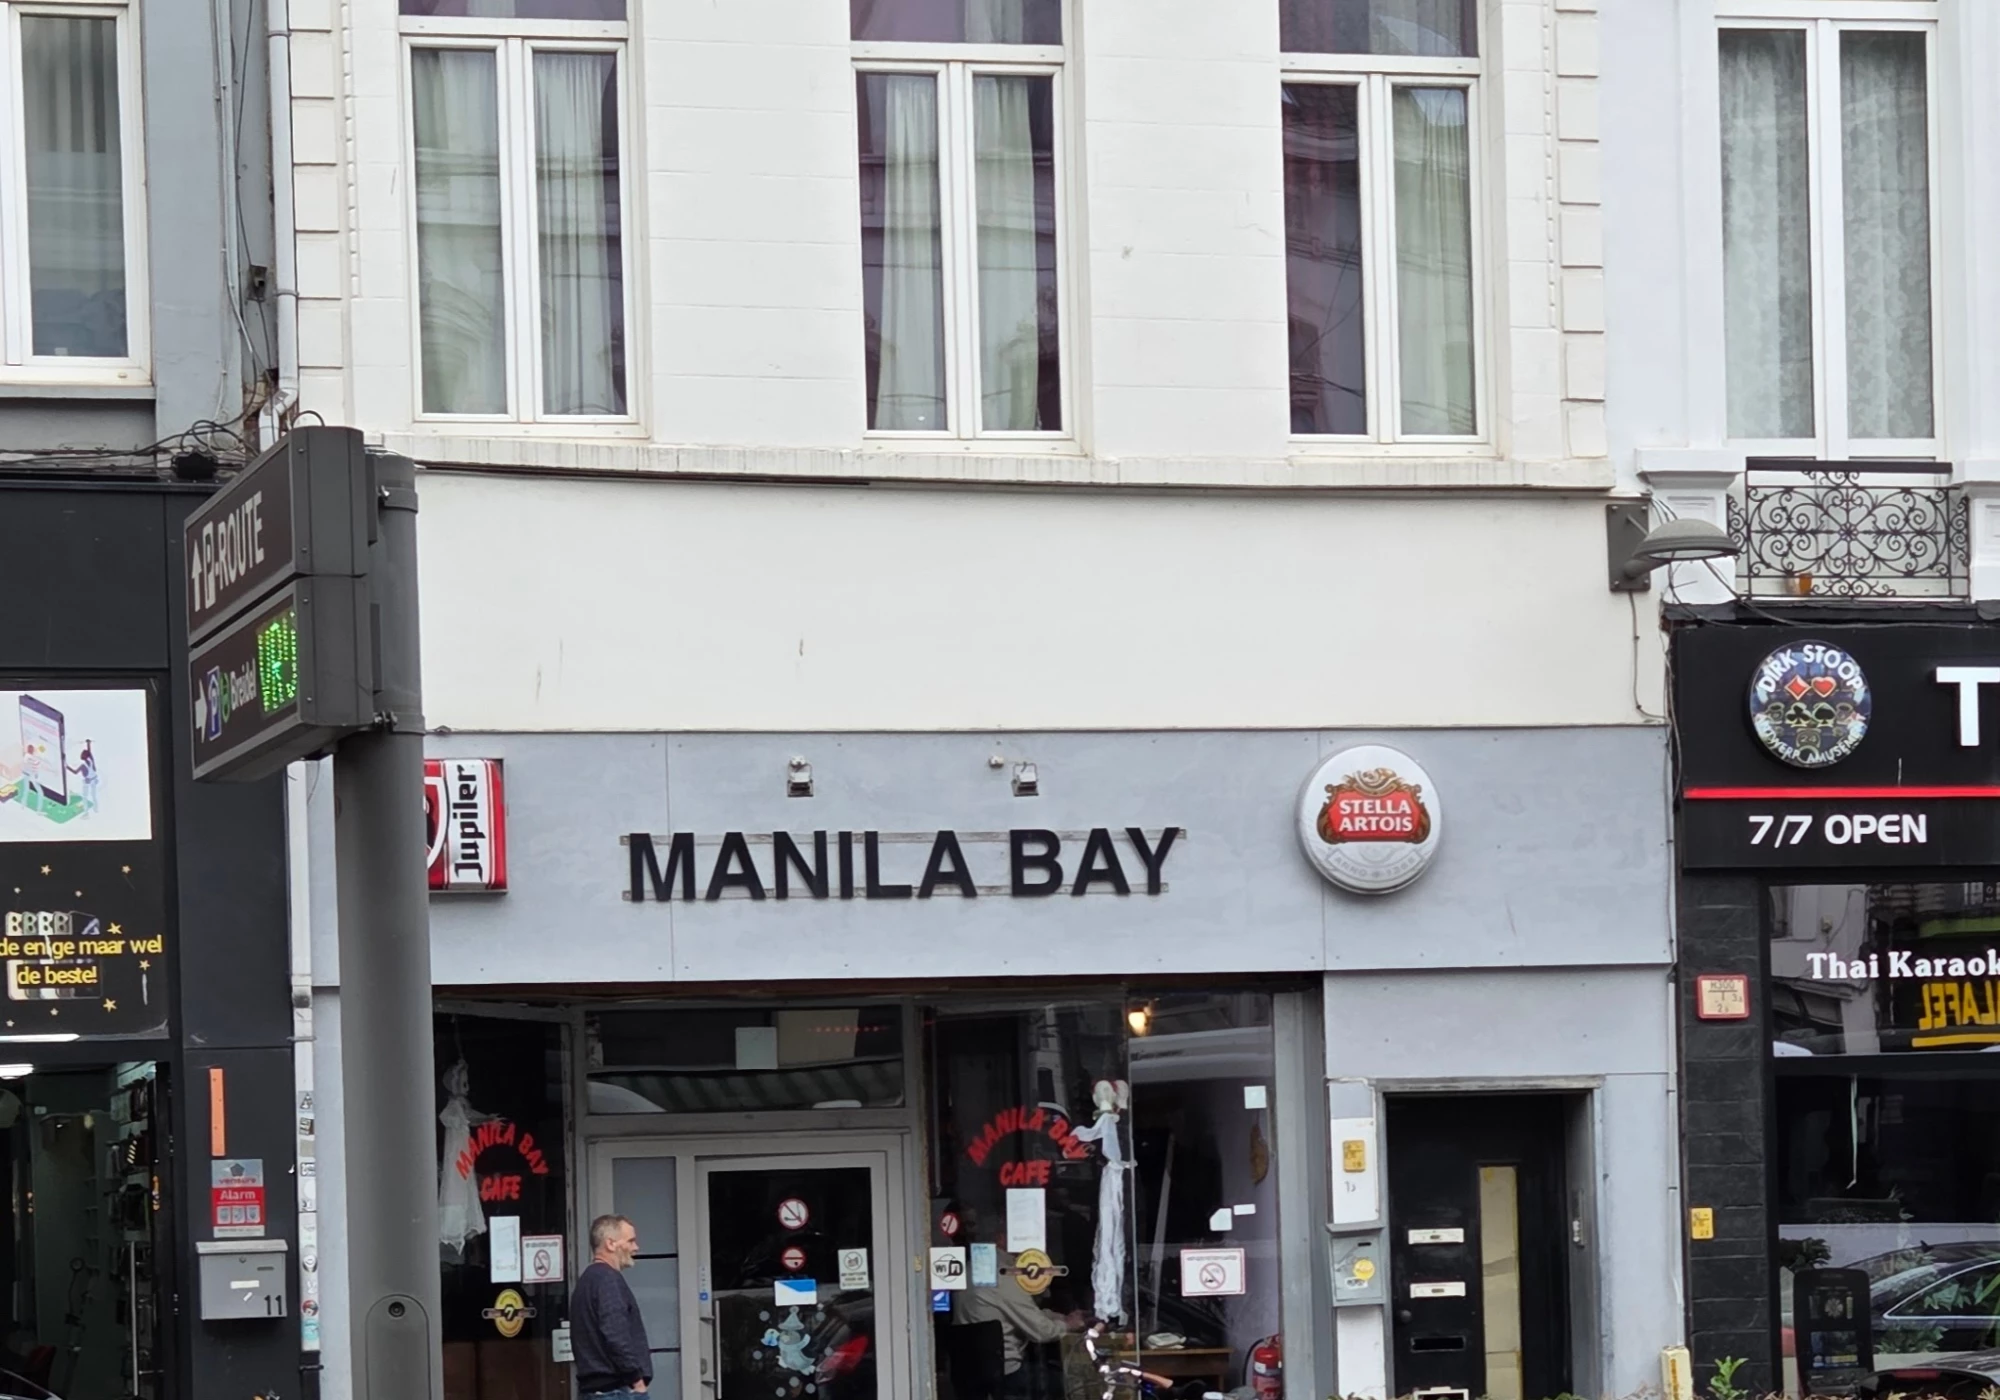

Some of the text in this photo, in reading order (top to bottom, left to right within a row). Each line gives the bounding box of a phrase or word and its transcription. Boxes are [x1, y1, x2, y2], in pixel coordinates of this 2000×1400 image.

[203, 491, 264, 609] P-ROUTE
[1758, 644, 1863, 693] DIRK STOOP
[230, 658, 256, 711] Breidel
[1936, 667, 2000, 746] T
[1339, 799, 1412, 815] STELLA
[452, 764, 486, 882] Jupiler
[1339, 816, 1413, 832] ARTOIS
[1749, 814, 1927, 848] 7/7 OPEN
[628, 826, 1180, 902] MANILA BAY
[0, 937, 20, 956] de
[79, 939, 126, 955] maar
[129, 934, 163, 954] wel
[17, 966, 98, 984] de beste!
[1807, 952, 1879, 979] Thai
[456, 1121, 549, 1180] MANILA BAY
[967, 1105, 1046, 1167] MANILA
[1000, 1160, 1052, 1186] CAFE
[220, 1190, 256, 1200] Alarm
[480, 1175, 521, 1202] CAFE
[264, 1295, 282, 1315] 11
